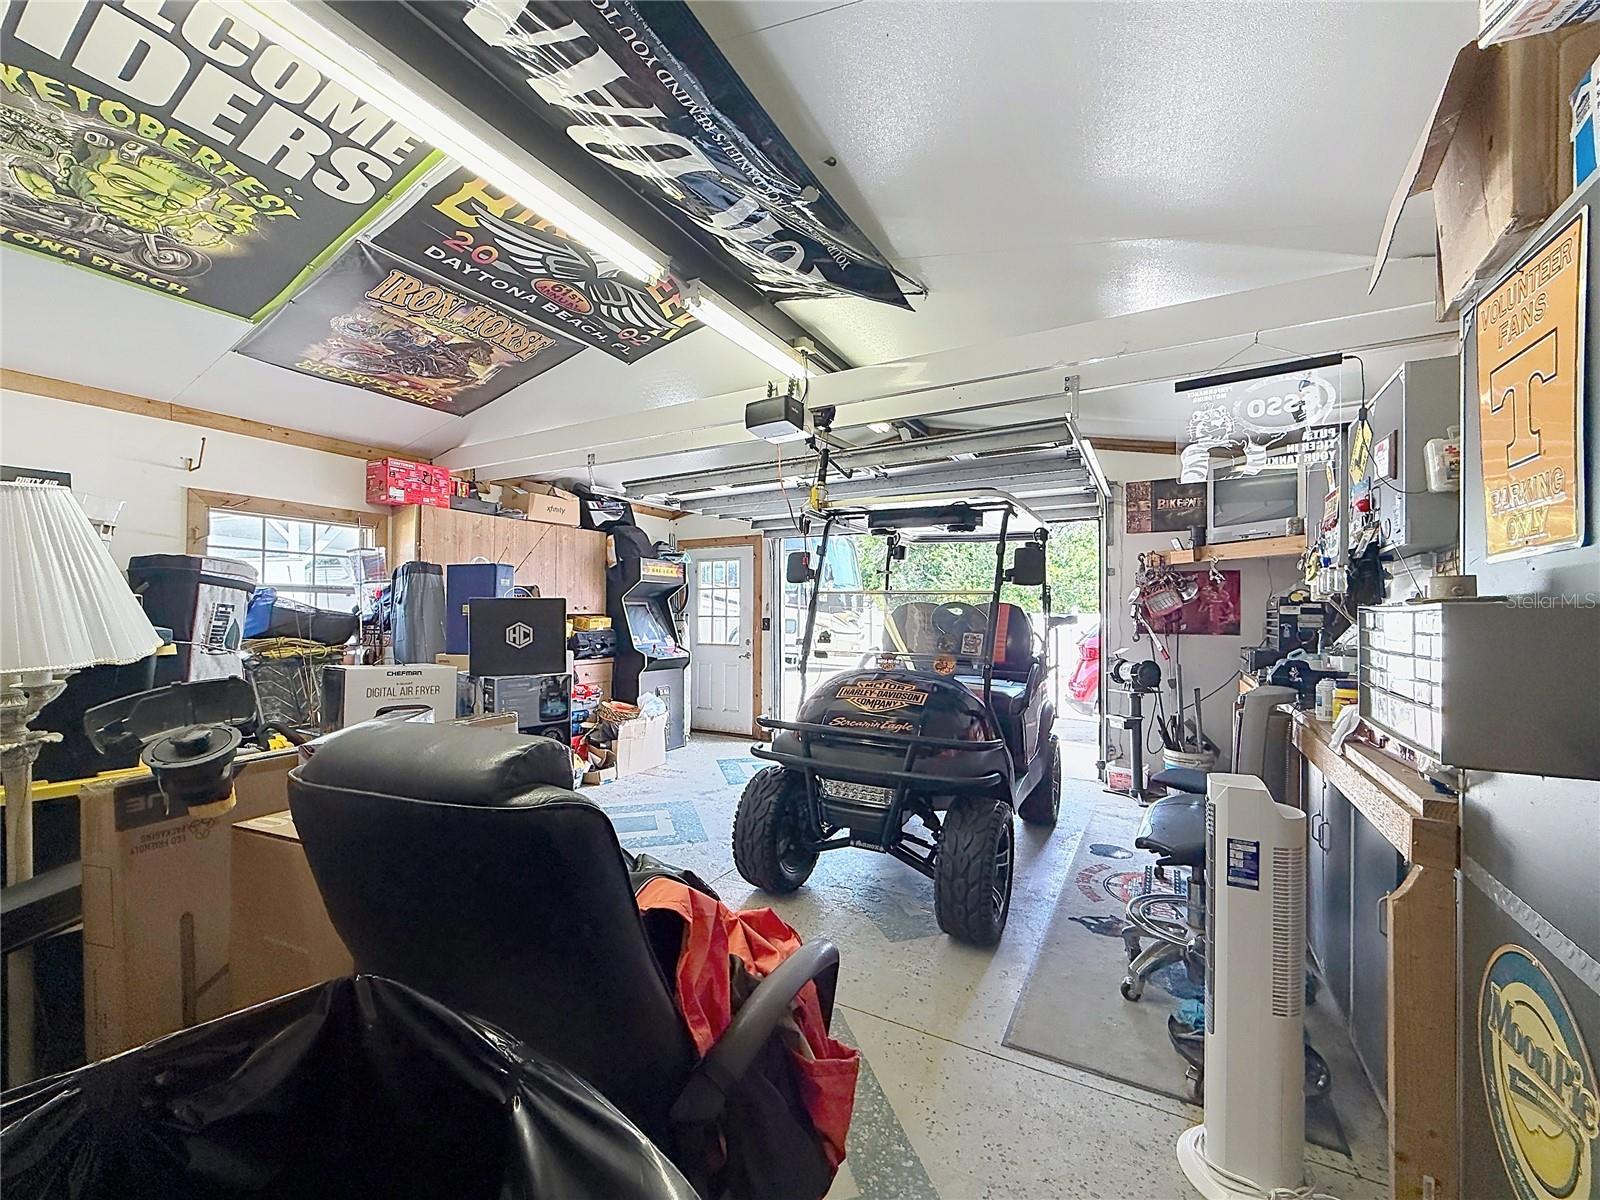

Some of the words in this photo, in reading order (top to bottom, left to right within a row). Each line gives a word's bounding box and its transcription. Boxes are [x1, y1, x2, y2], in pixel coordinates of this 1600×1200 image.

[615, 26, 660, 69] YOU
[0, 0, 393, 205] IDERS
[111, 0, 424, 166] LCOME
[656, 69, 718, 133] REMIND
[712, 132, 764, 190] DANIEL'S
[443, 231, 499, 266] 20
[89, 255, 190, 295] BEACH
[551, 283, 584, 304] 61ST
[1480, 237, 1573, 332] VOLUNTEER
[366, 269, 467, 320] IRON
[462, 305, 557, 361] HORSE
[424, 246, 538, 304] DAYTONA
[611, 342, 633, 356] FL
[1497, 292, 1547, 350] FANS
[1489, 326, 1558, 470] T
[15, 476, 43, 487] DIRTY
[43, 479, 60, 487] AIR
[1491, 466, 1566, 515] PARKING
[1505, 504, 1550, 543] ONLY
[509, 627, 530, 645] HC
[366, 687, 397, 698] DIGITAL
[400, 686, 414, 697] AIR
[415, 685, 441, 696] FRYER
[843, 687, 921, 702] HARLEY-DAVIDSON
[857, 698, 898, 709] COMPANY
[880, 721, 914, 734] Eagle
